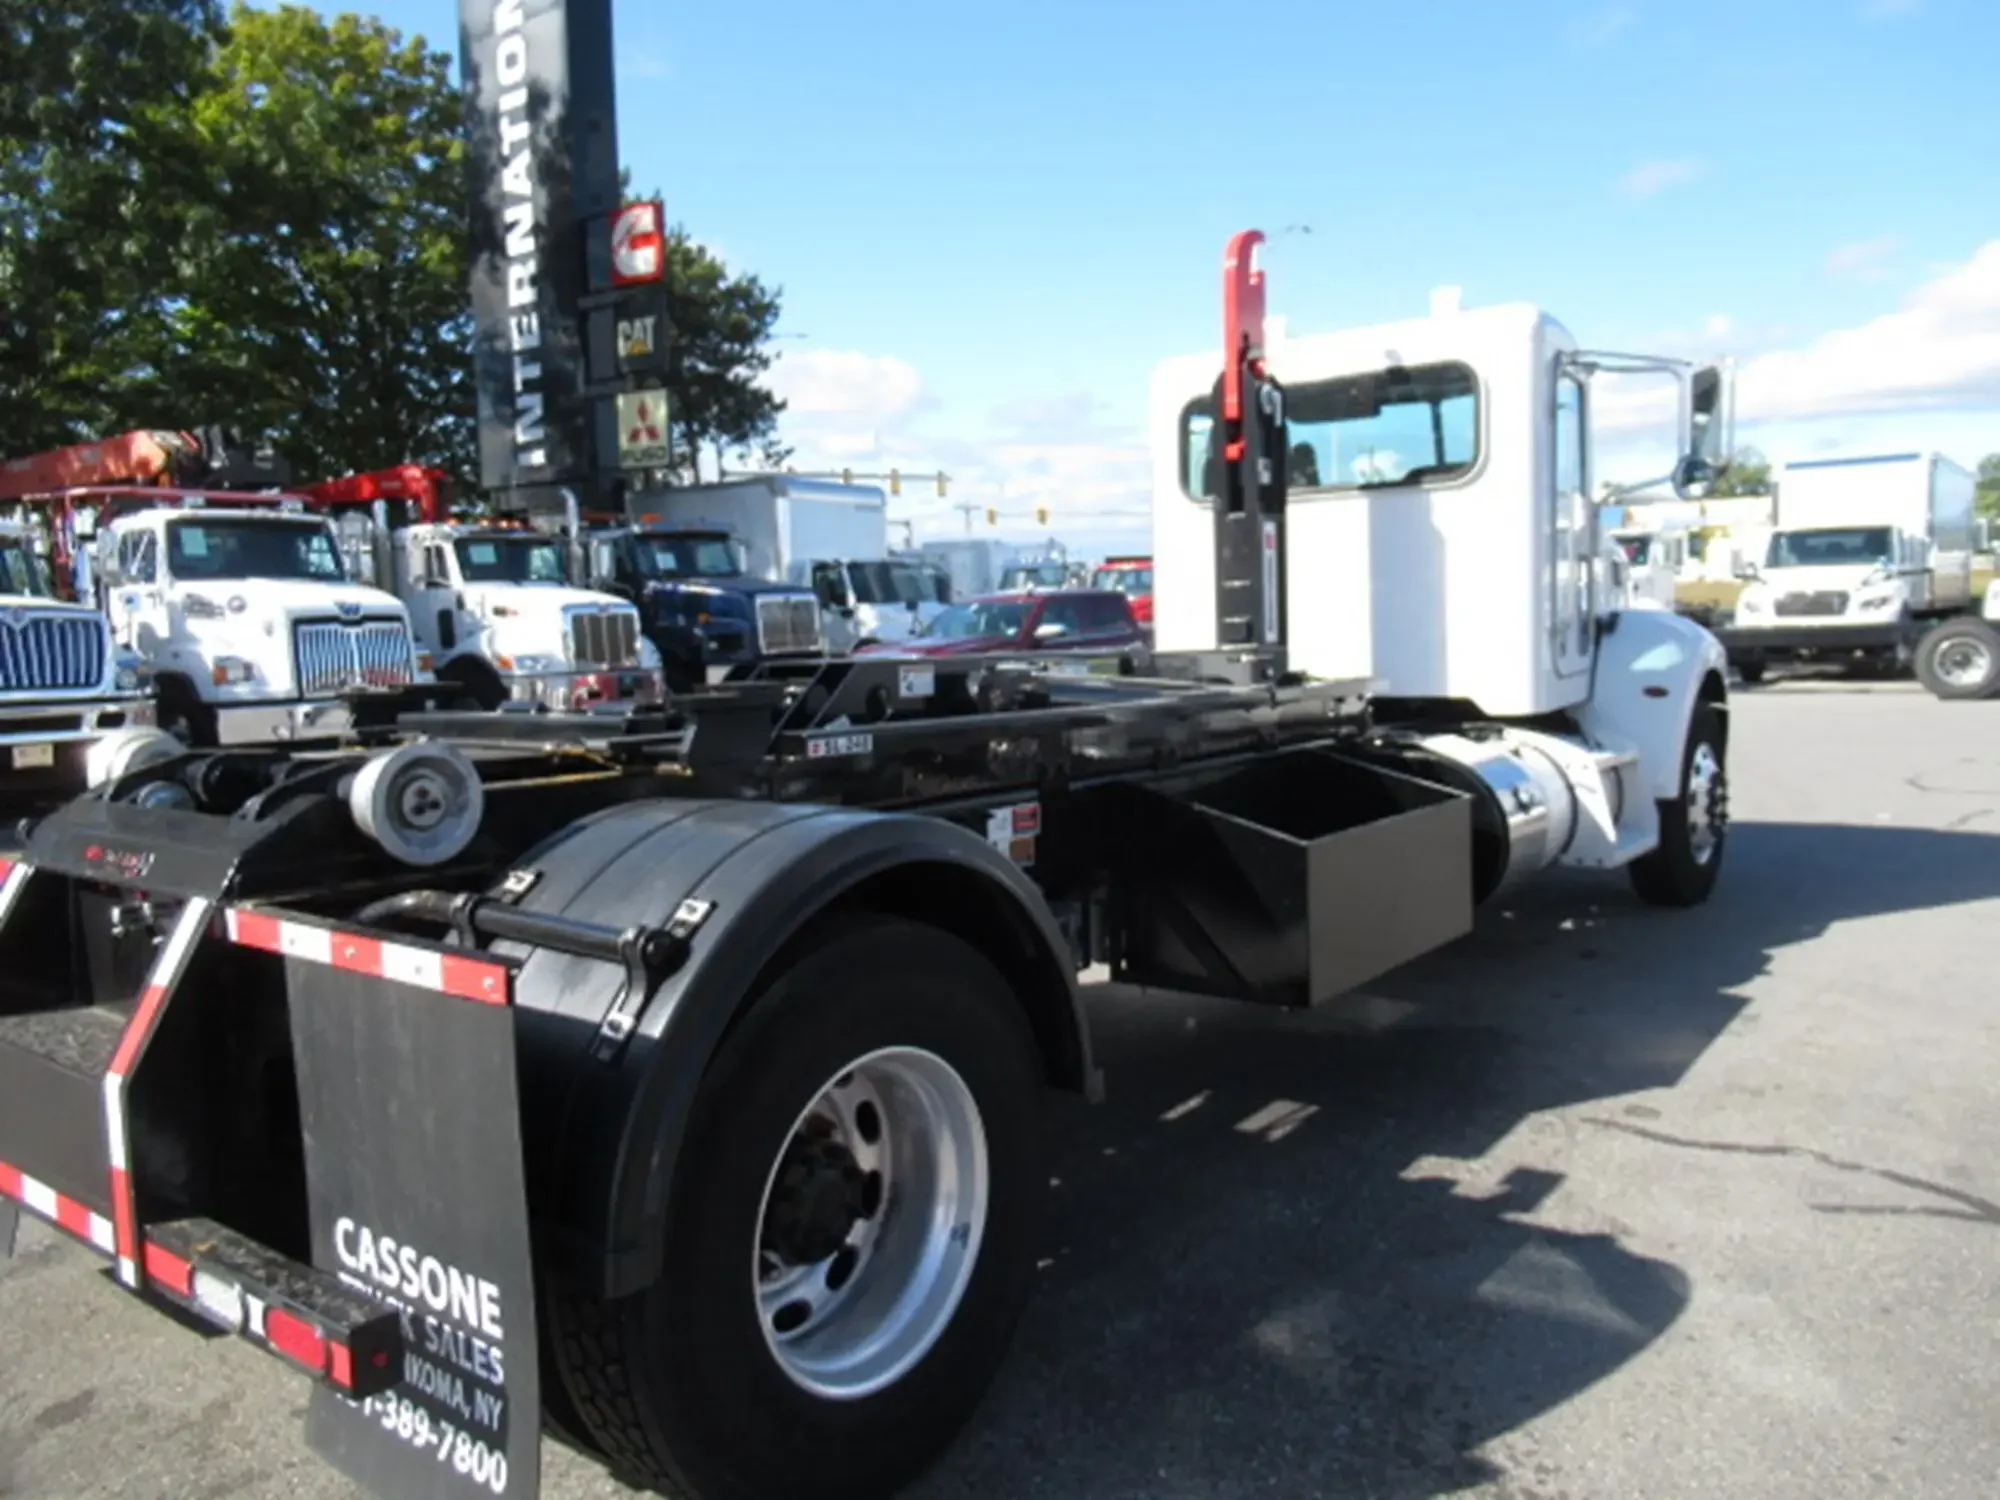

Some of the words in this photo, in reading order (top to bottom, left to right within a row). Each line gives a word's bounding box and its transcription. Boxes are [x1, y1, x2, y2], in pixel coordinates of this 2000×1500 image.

[617, 315, 656, 358] CAT
[334, 1216, 504, 1340] CASSONE
[424, 1315, 504, 1385] SALES
[474, 1387, 504, 1431] NY
